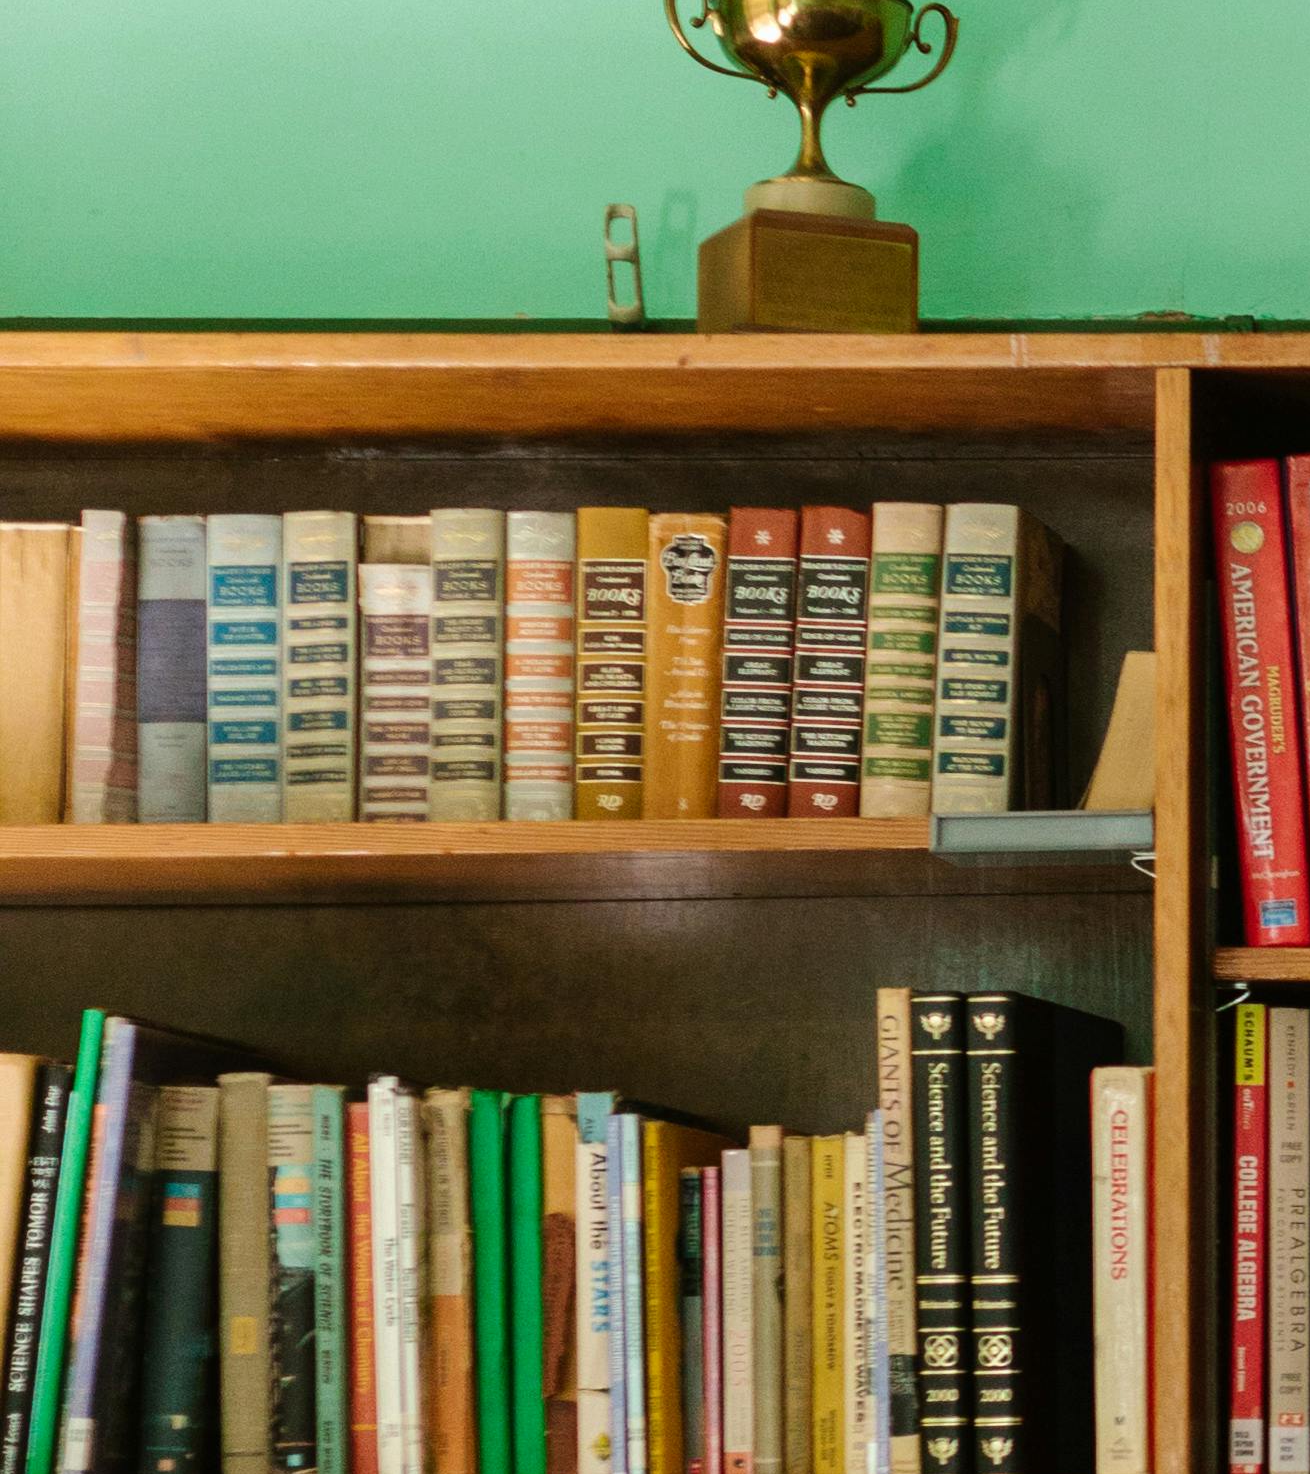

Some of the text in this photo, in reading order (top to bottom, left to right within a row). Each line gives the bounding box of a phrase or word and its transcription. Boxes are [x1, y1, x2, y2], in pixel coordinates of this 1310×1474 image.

[1225, 501, 1268, 517] 2006
[587, 588, 642, 605] BOOKS
[734, 587, 789, 604] BOOKS
[1228, 562, 1276, 861] AMERICAN GOVERNMENT
[1267, 664, 1287, 757] MAGRUDER'S
[1241, 1008, 1257, 1084] SCHAUM'S
[878, 1013, 914, 1291] GIANTS OF Medicine
[927, 1062, 952, 1270] Science and the Future
[1109, 1108, 1129, 1281] CELEBRATIONS
[1235, 1154, 1259, 1323] COLLEGE ALGEBRA
[1288, 1186, 1306, 1354] PREALGEBRA
[925, 1388, 959, 1403] 2000
